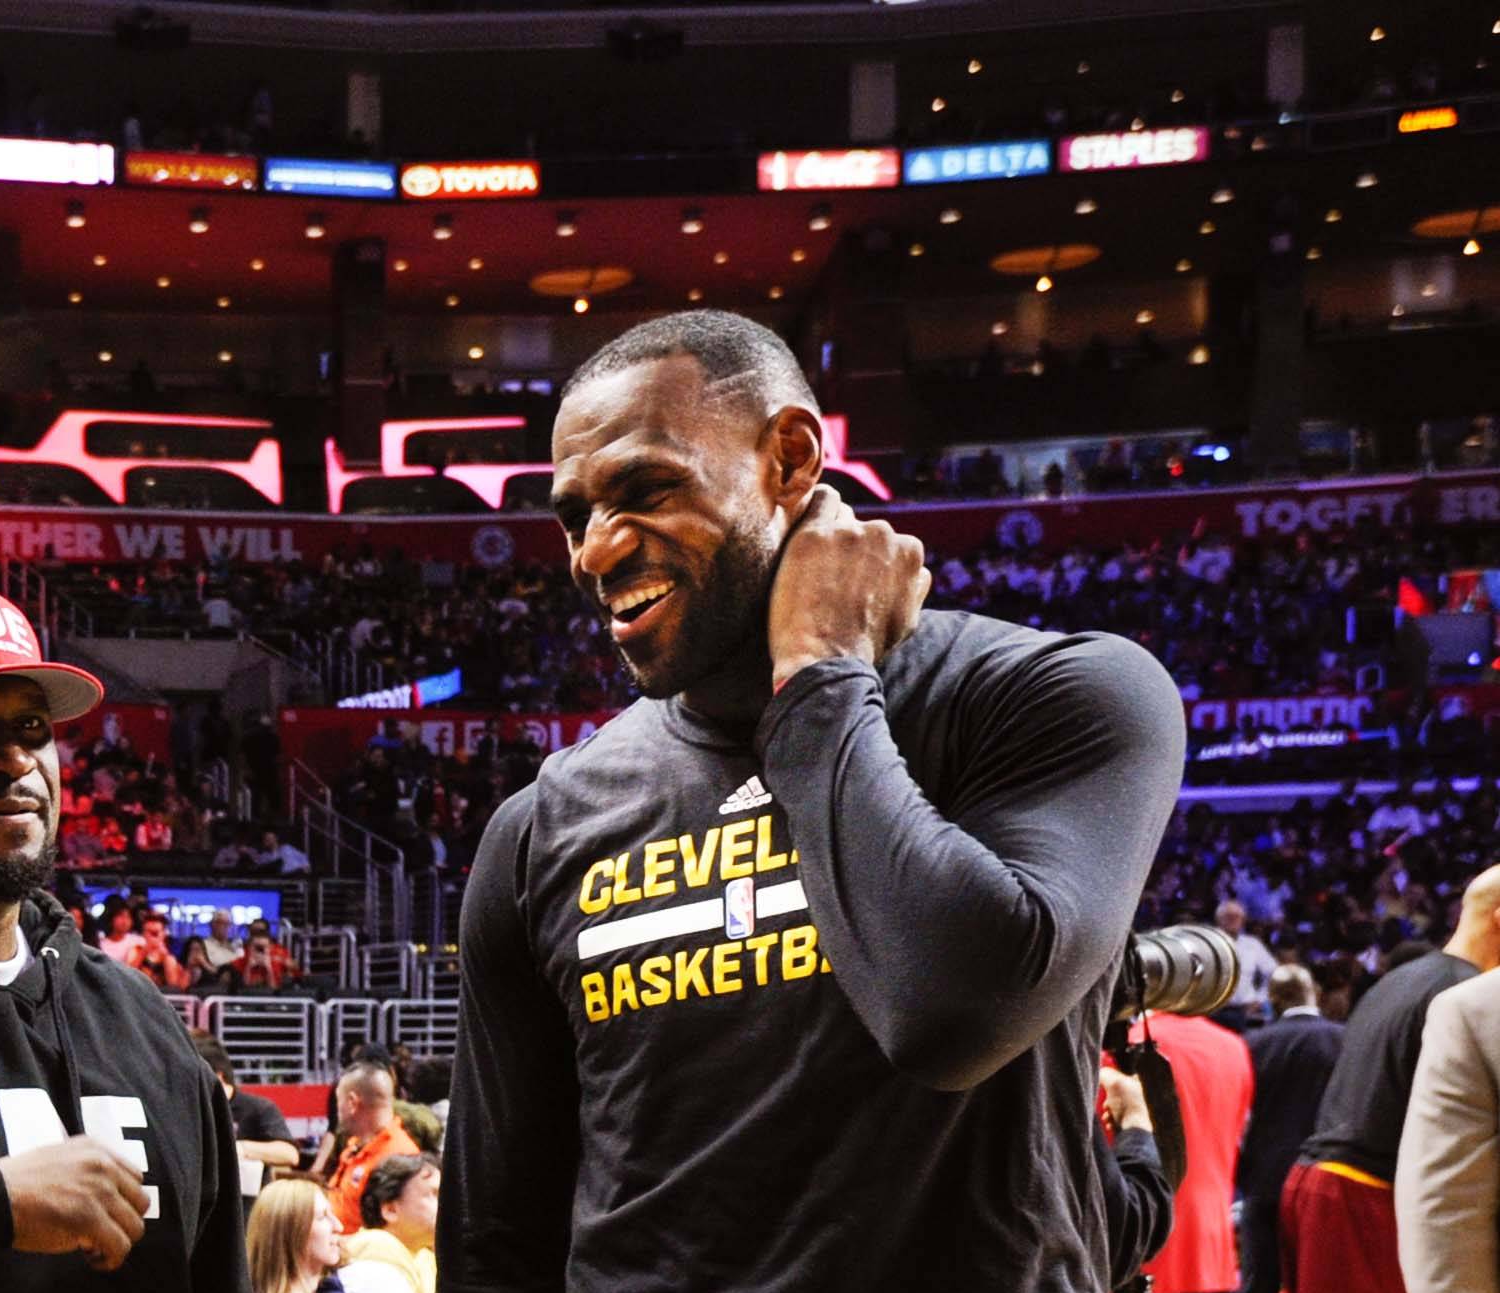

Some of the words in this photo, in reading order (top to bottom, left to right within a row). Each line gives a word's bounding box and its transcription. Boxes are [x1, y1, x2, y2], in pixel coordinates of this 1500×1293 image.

[942, 142, 1049, 175] DELTA
[1069, 129, 1199, 170] STAPLES
[439, 165, 538, 193] TOYOTA
[113, 522, 185, 559] WE
[199, 526, 302, 563] WILL
[578, 815, 798, 914] CLEVEL
[580, 924, 833, 1023] BASKETB
